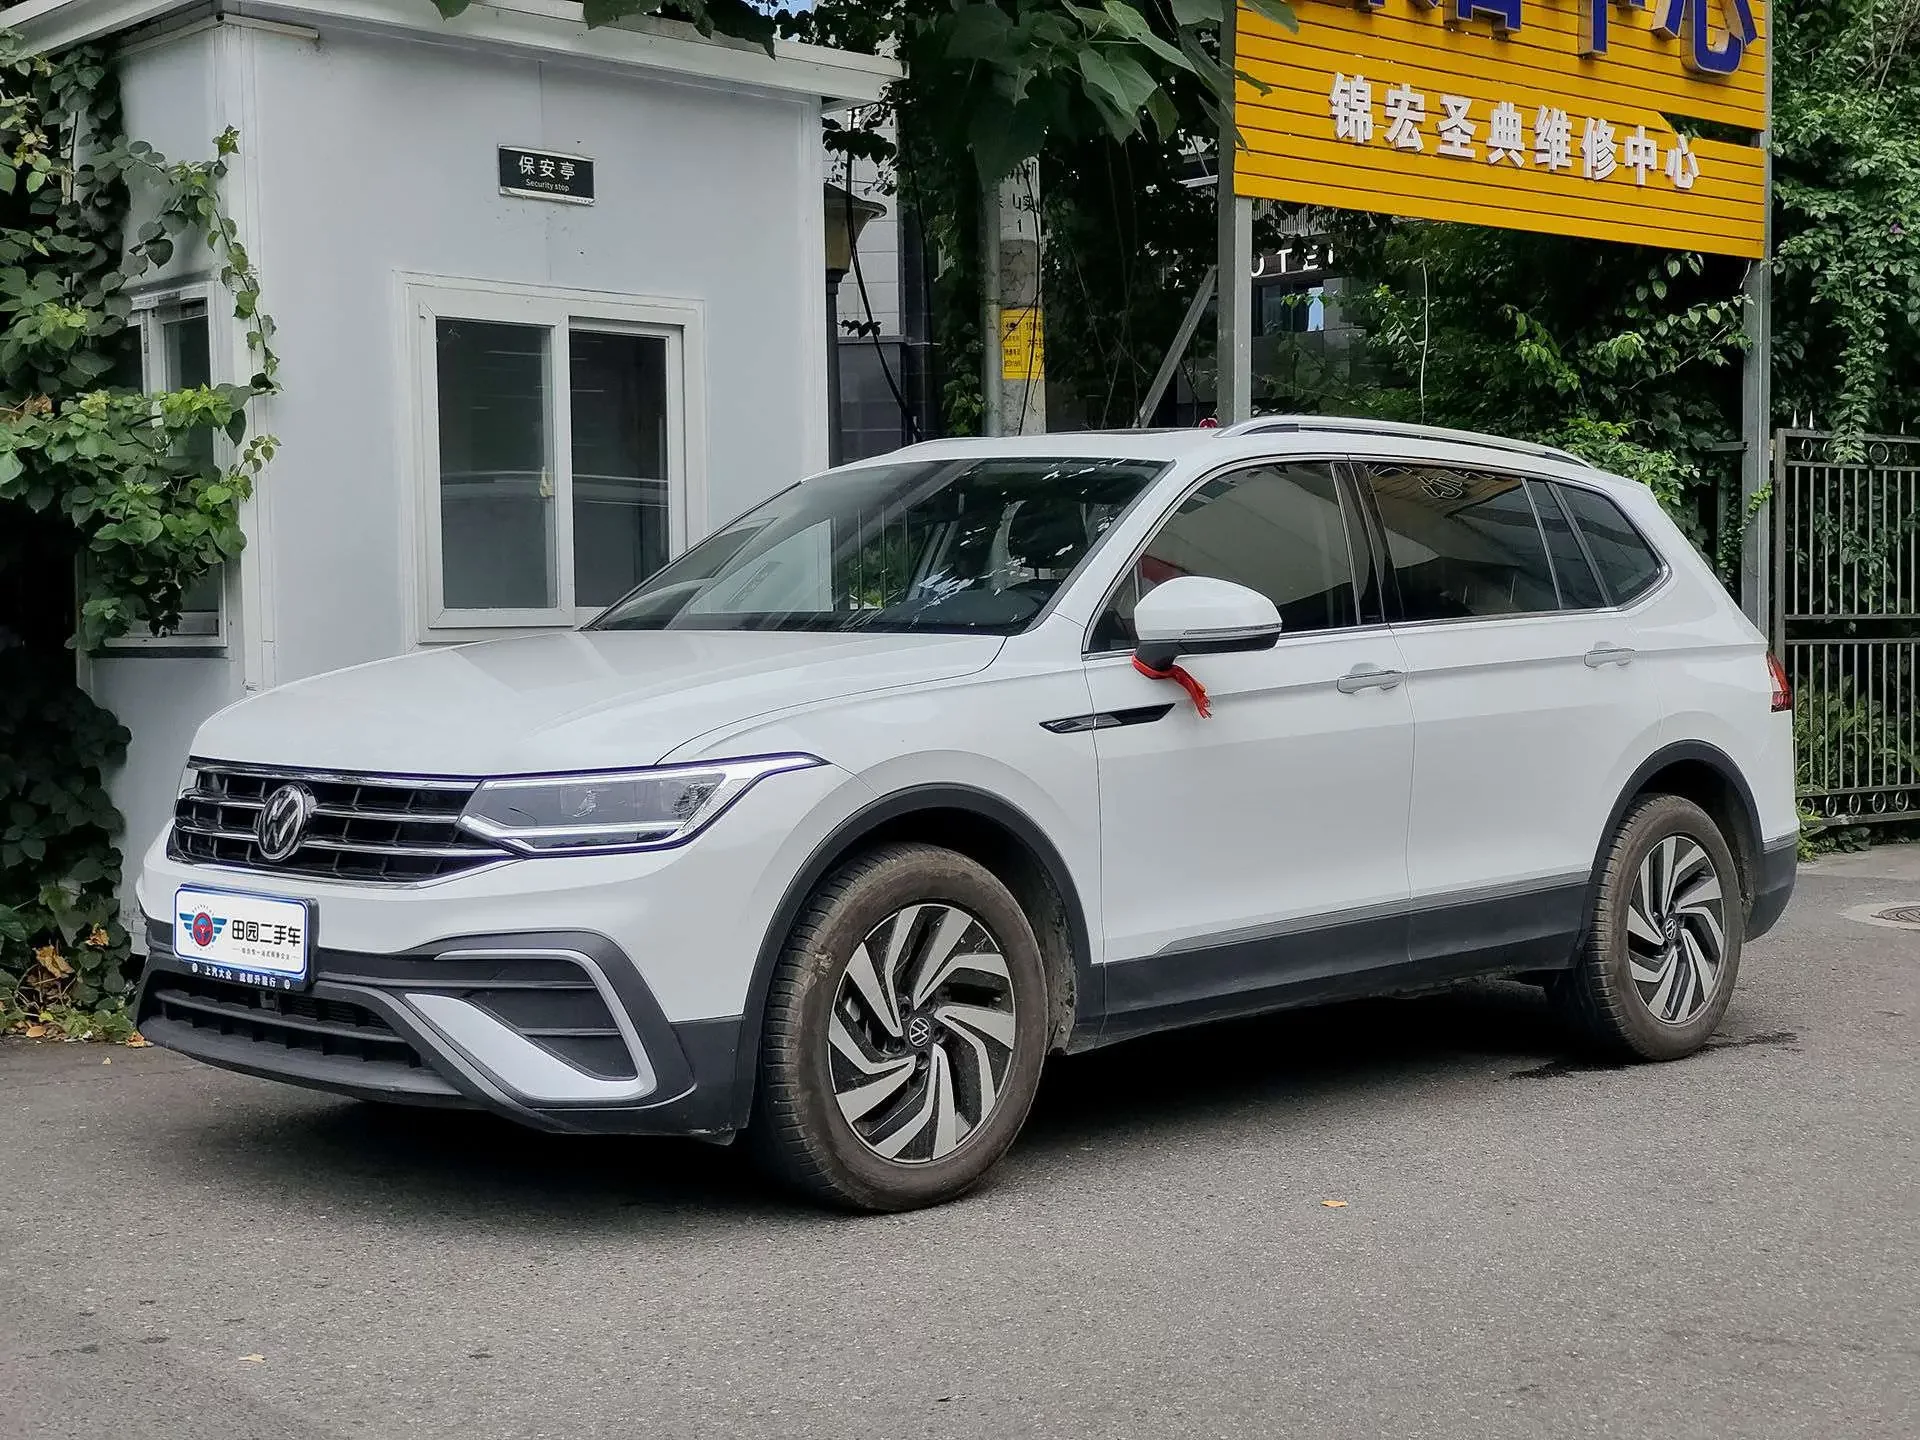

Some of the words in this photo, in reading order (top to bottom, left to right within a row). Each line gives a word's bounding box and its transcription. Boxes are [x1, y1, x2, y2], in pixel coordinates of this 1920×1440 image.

[1329, 71, 1700, 190] 锦宏圣典维修中心
[519, 155, 575, 180] 保安亭
[525, 179, 553, 191] Security
[554, 183, 570, 193] stop
[232, 919, 301, 947] 田园二手车
[204, 966, 233, 980] 上汽大众
